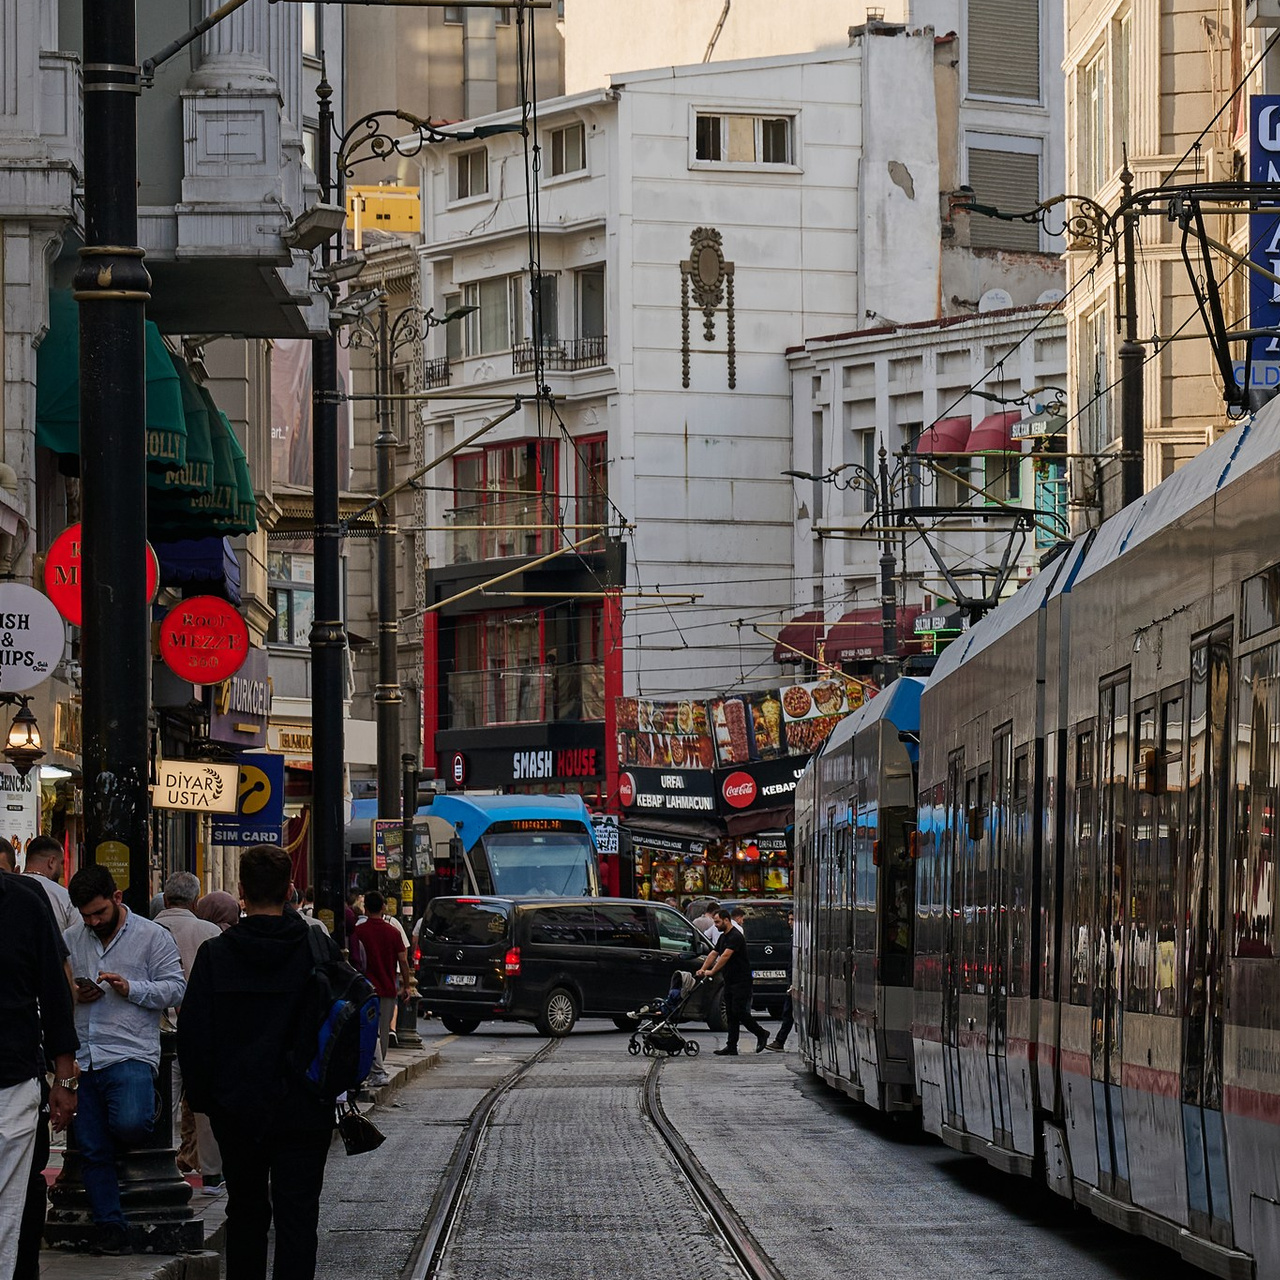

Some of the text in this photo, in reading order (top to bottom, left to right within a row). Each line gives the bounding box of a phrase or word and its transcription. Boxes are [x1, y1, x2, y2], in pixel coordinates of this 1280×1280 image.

[146, 429, 180, 460] OLLY
[1, 631, 15, 648] &
[167, 631, 242, 650] MEZZE
[232, 676, 272, 717] TURKCELL
[513, 748, 596, 780] SMASH HOUSE
[165, 771, 213, 792] DİYAR
[660, 775, 685, 789] URFA
[762, 782, 797, 796] KEBAP
[167, 789, 209, 807] USTA
[636, 793, 714, 811] KEBAP LAHMACUN
[214, 830, 279, 843] SIM CARD
